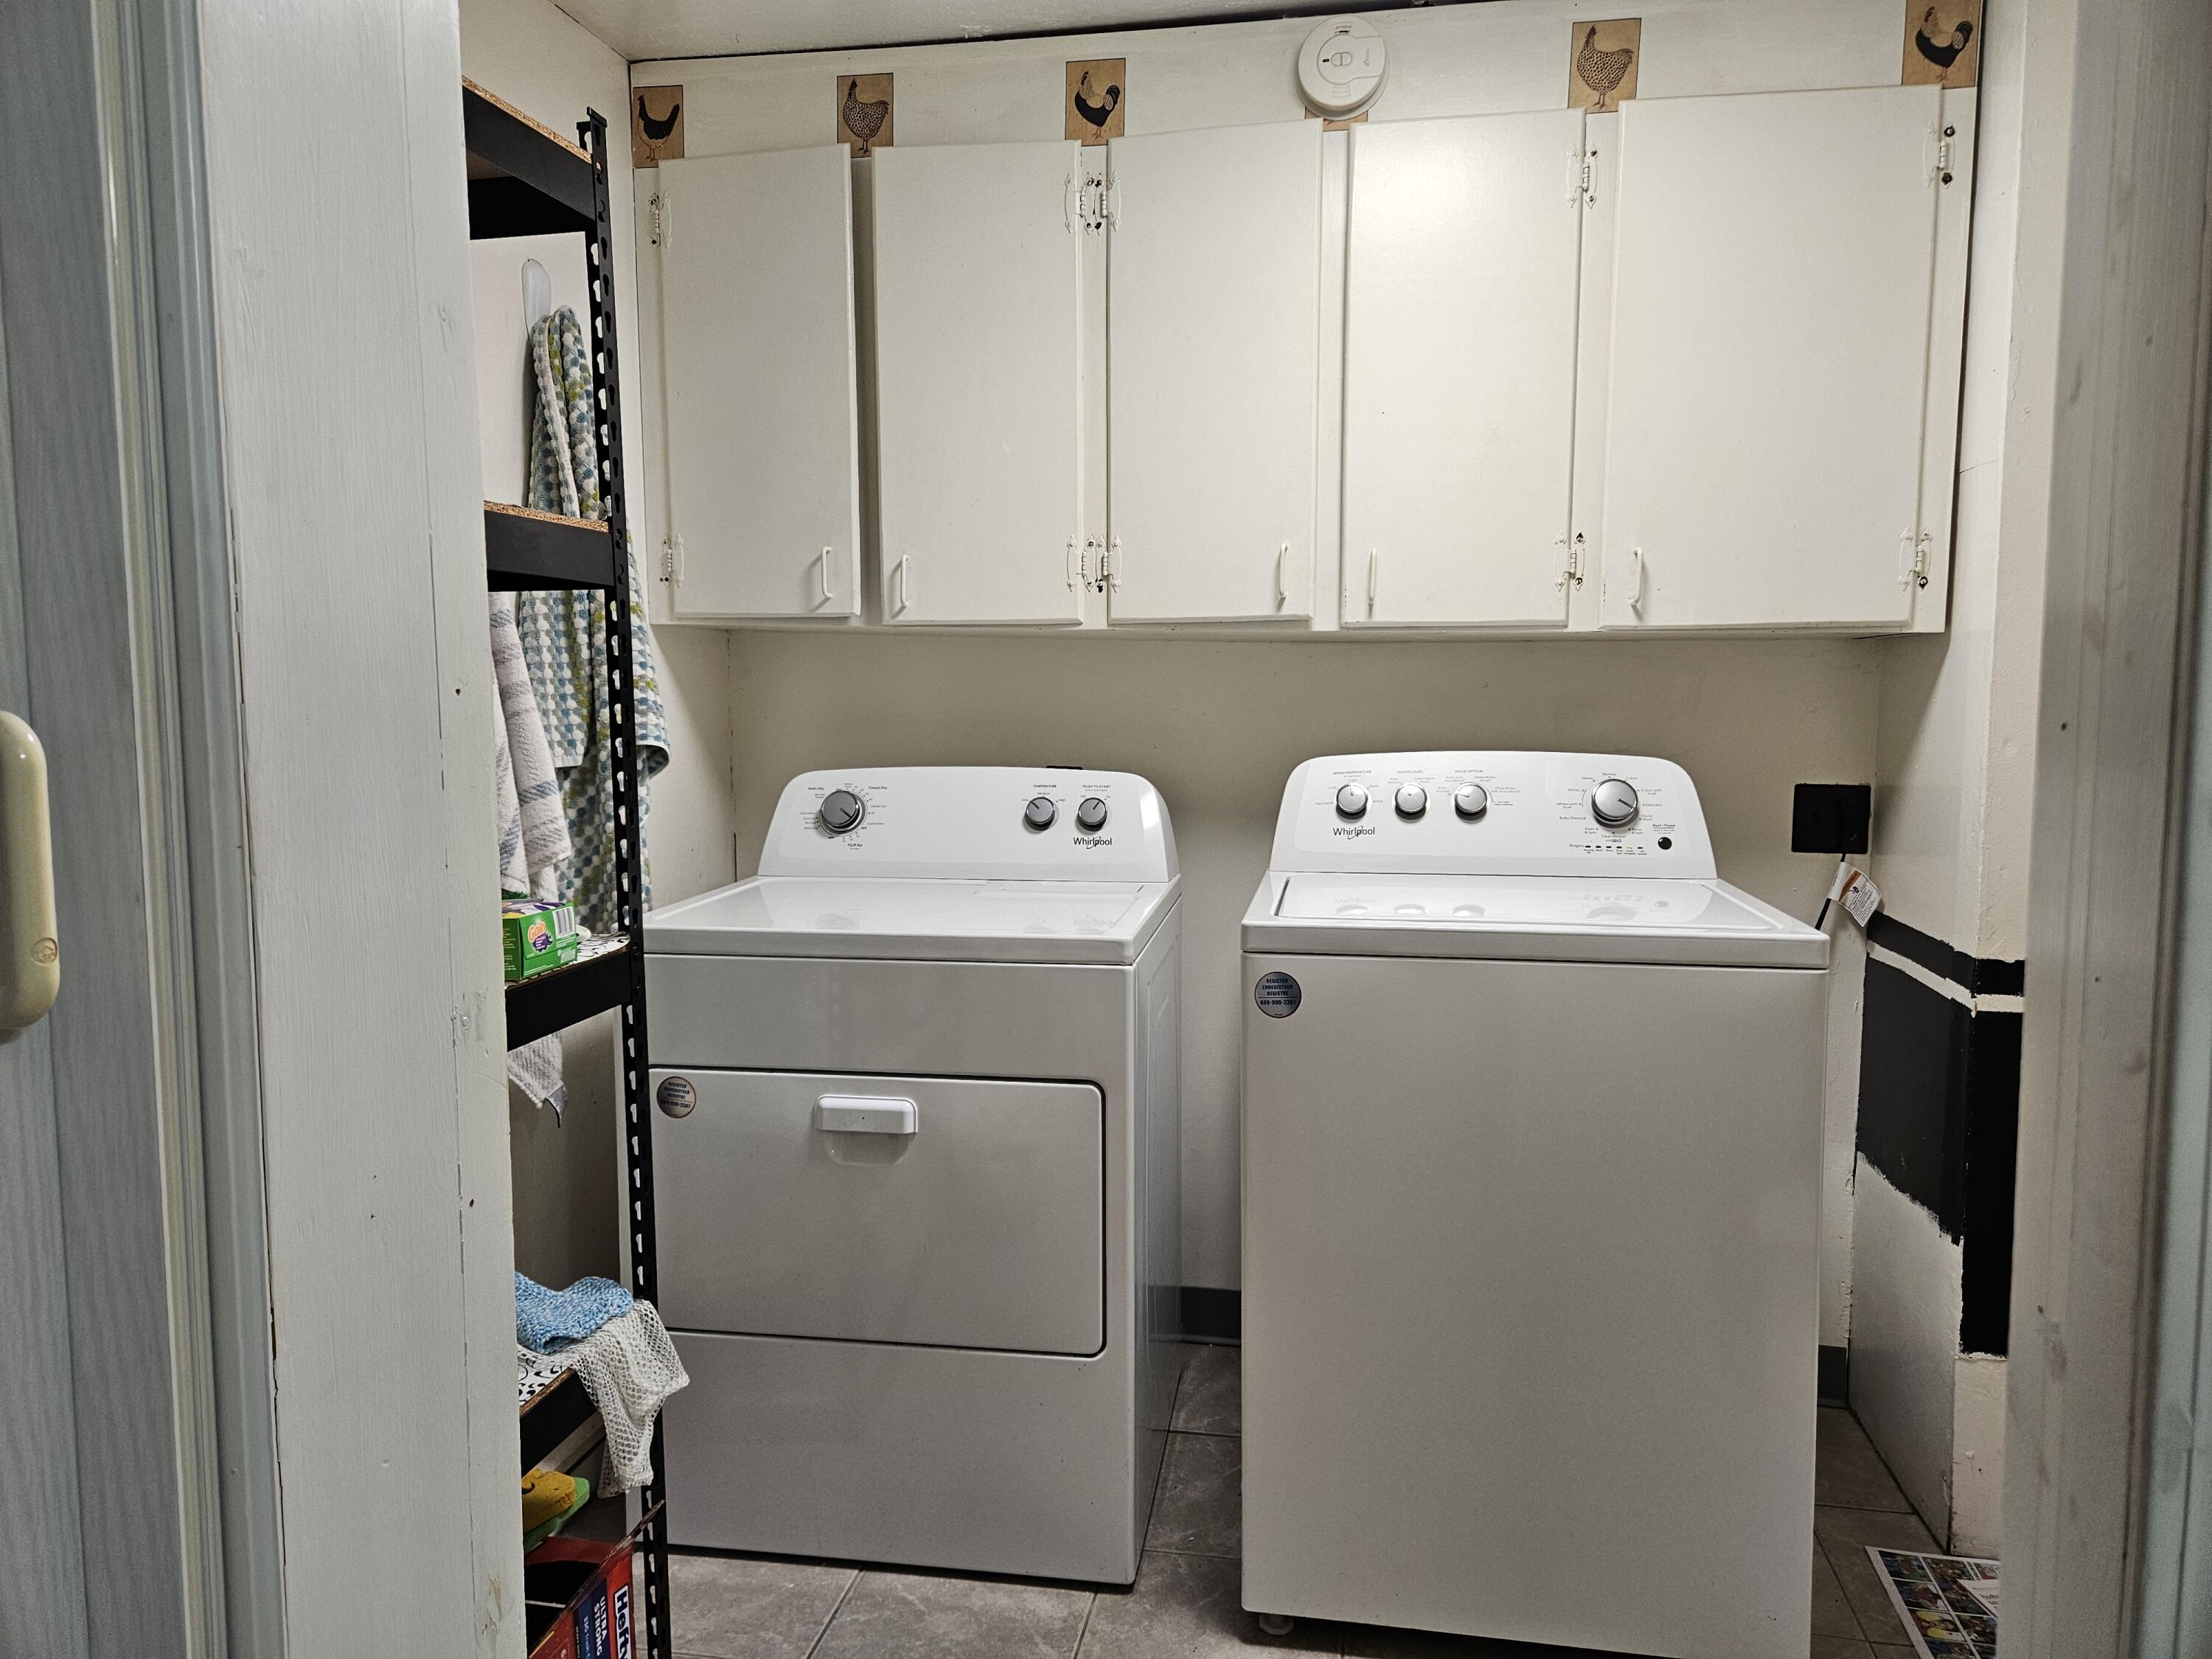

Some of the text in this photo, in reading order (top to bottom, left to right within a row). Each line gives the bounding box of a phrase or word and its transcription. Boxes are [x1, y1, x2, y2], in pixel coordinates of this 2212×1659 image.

[1073, 836, 1113, 849] Whirlpool
[1333, 826, 1376, 839] Whirlpool
[594, 1603, 602, 1656] STRONG
[599, 1596, 608, 1641] ULTRA
